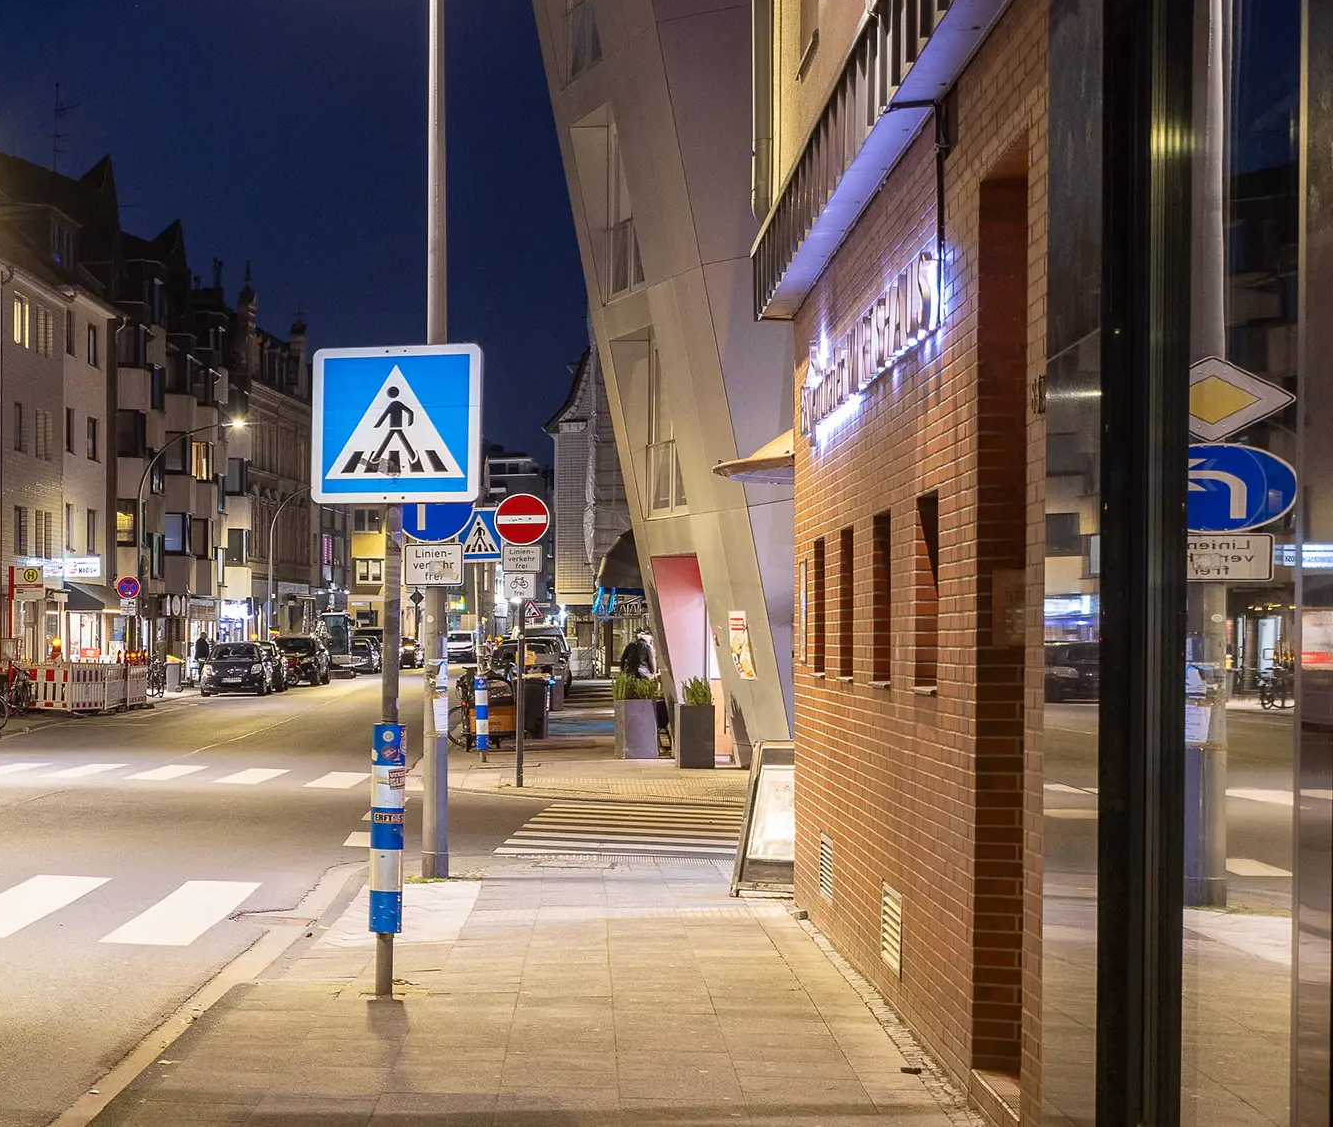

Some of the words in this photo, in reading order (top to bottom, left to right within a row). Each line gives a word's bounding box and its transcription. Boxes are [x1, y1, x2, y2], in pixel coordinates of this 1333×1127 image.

[414, 549, 453, 558] Linien-
[413, 560, 455, 570] verhr
[425, 571, 443, 581] frei
